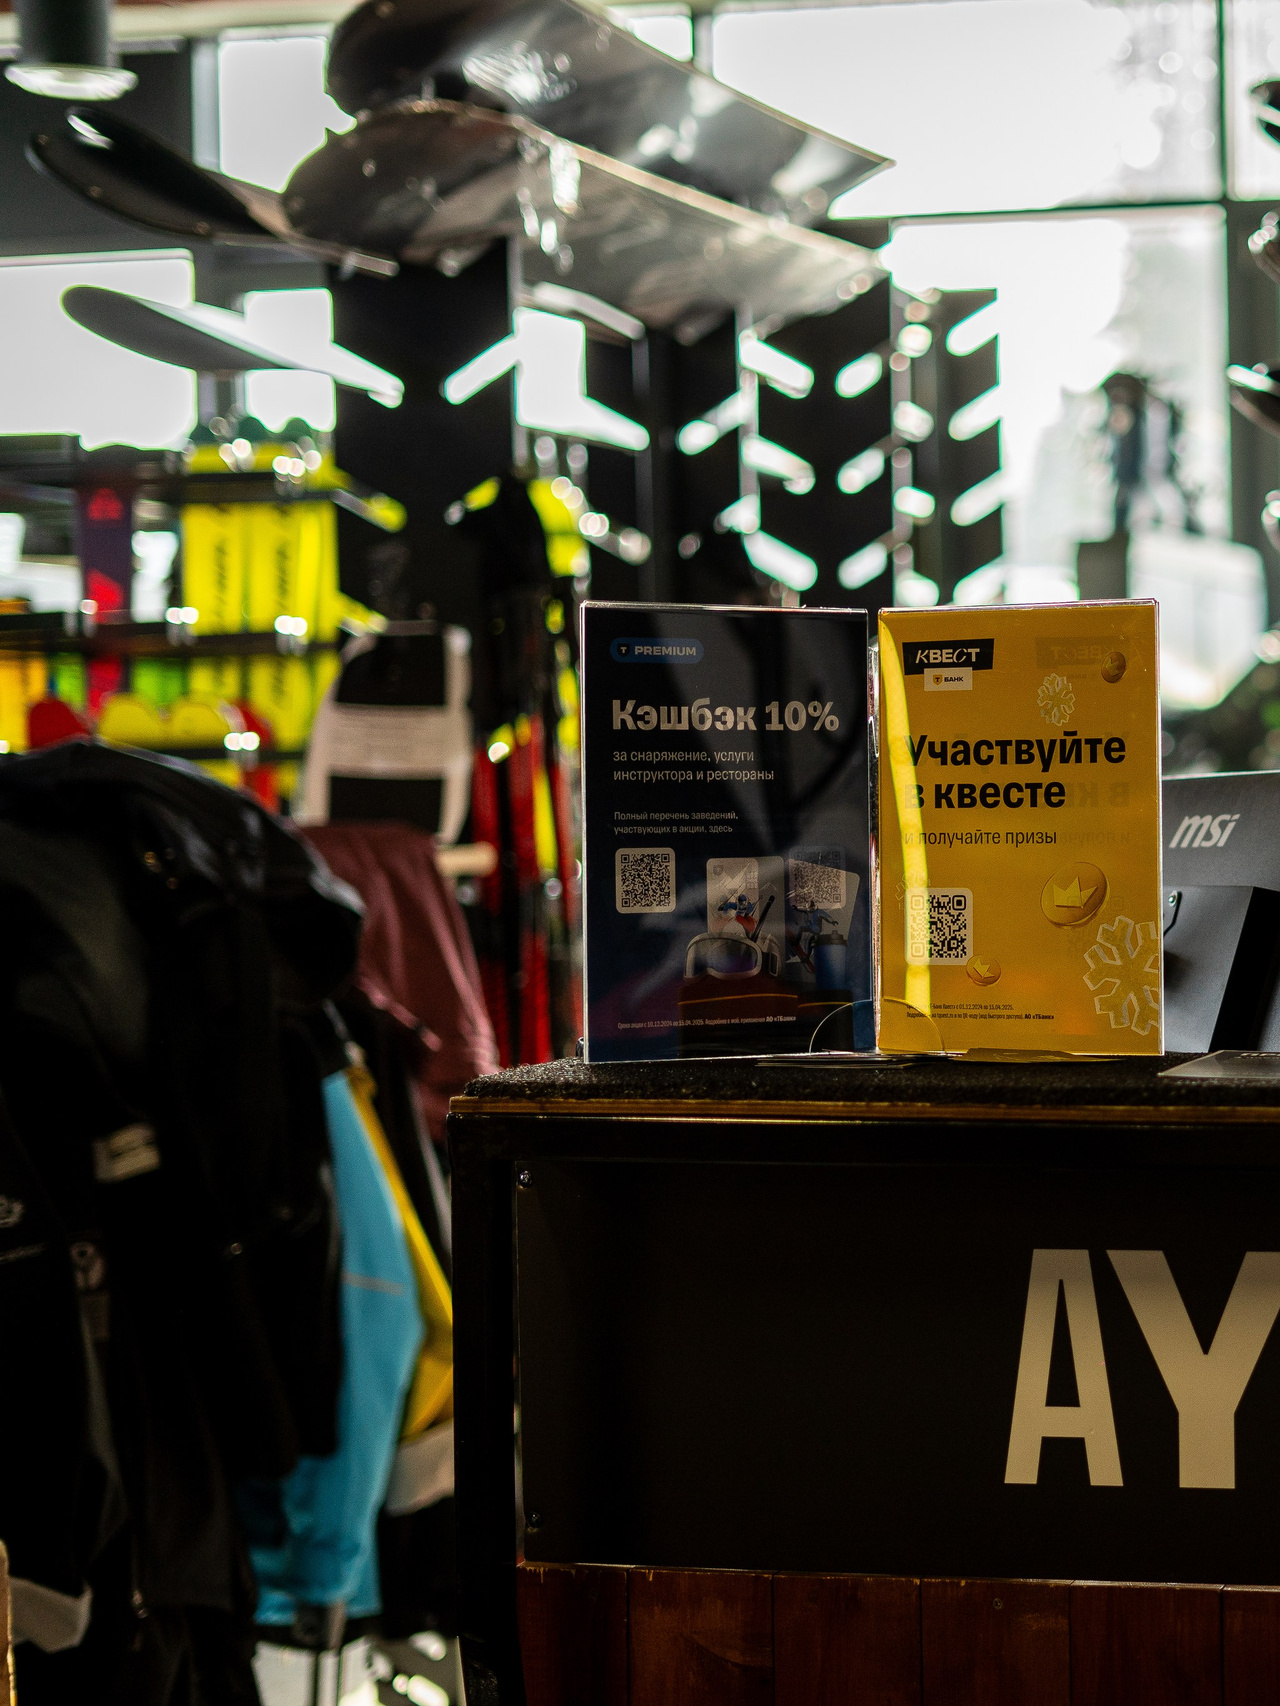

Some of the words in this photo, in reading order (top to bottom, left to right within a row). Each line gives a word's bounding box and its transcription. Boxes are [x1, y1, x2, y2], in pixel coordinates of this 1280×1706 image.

[634, 646, 696, 656] PREMIUM
[915, 648, 980, 664] КВЕСТ
[612, 698, 758, 731] Кэшбэк
[765, 700, 840, 731] 10%
[613, 751, 627, 761] за
[630, 751, 711, 764] снаряжение,
[714, 751, 754, 764] услуги
[902, 730, 1126, 772] Участвуйте
[614, 770, 693, 783] инструктора
[696, 770, 704, 780] и
[707, 770, 774, 783] рестораны
[905, 783, 924, 809] в
[934, 780, 1066, 809] квесте
[614, 811, 648, 820] Полный
[650, 812, 690, 822] перечень
[614, 826, 671, 836] участвующих
[905, 833, 913, 845] и
[919, 829, 1000, 848] получайте
[1006, 831, 1056, 848] призы
